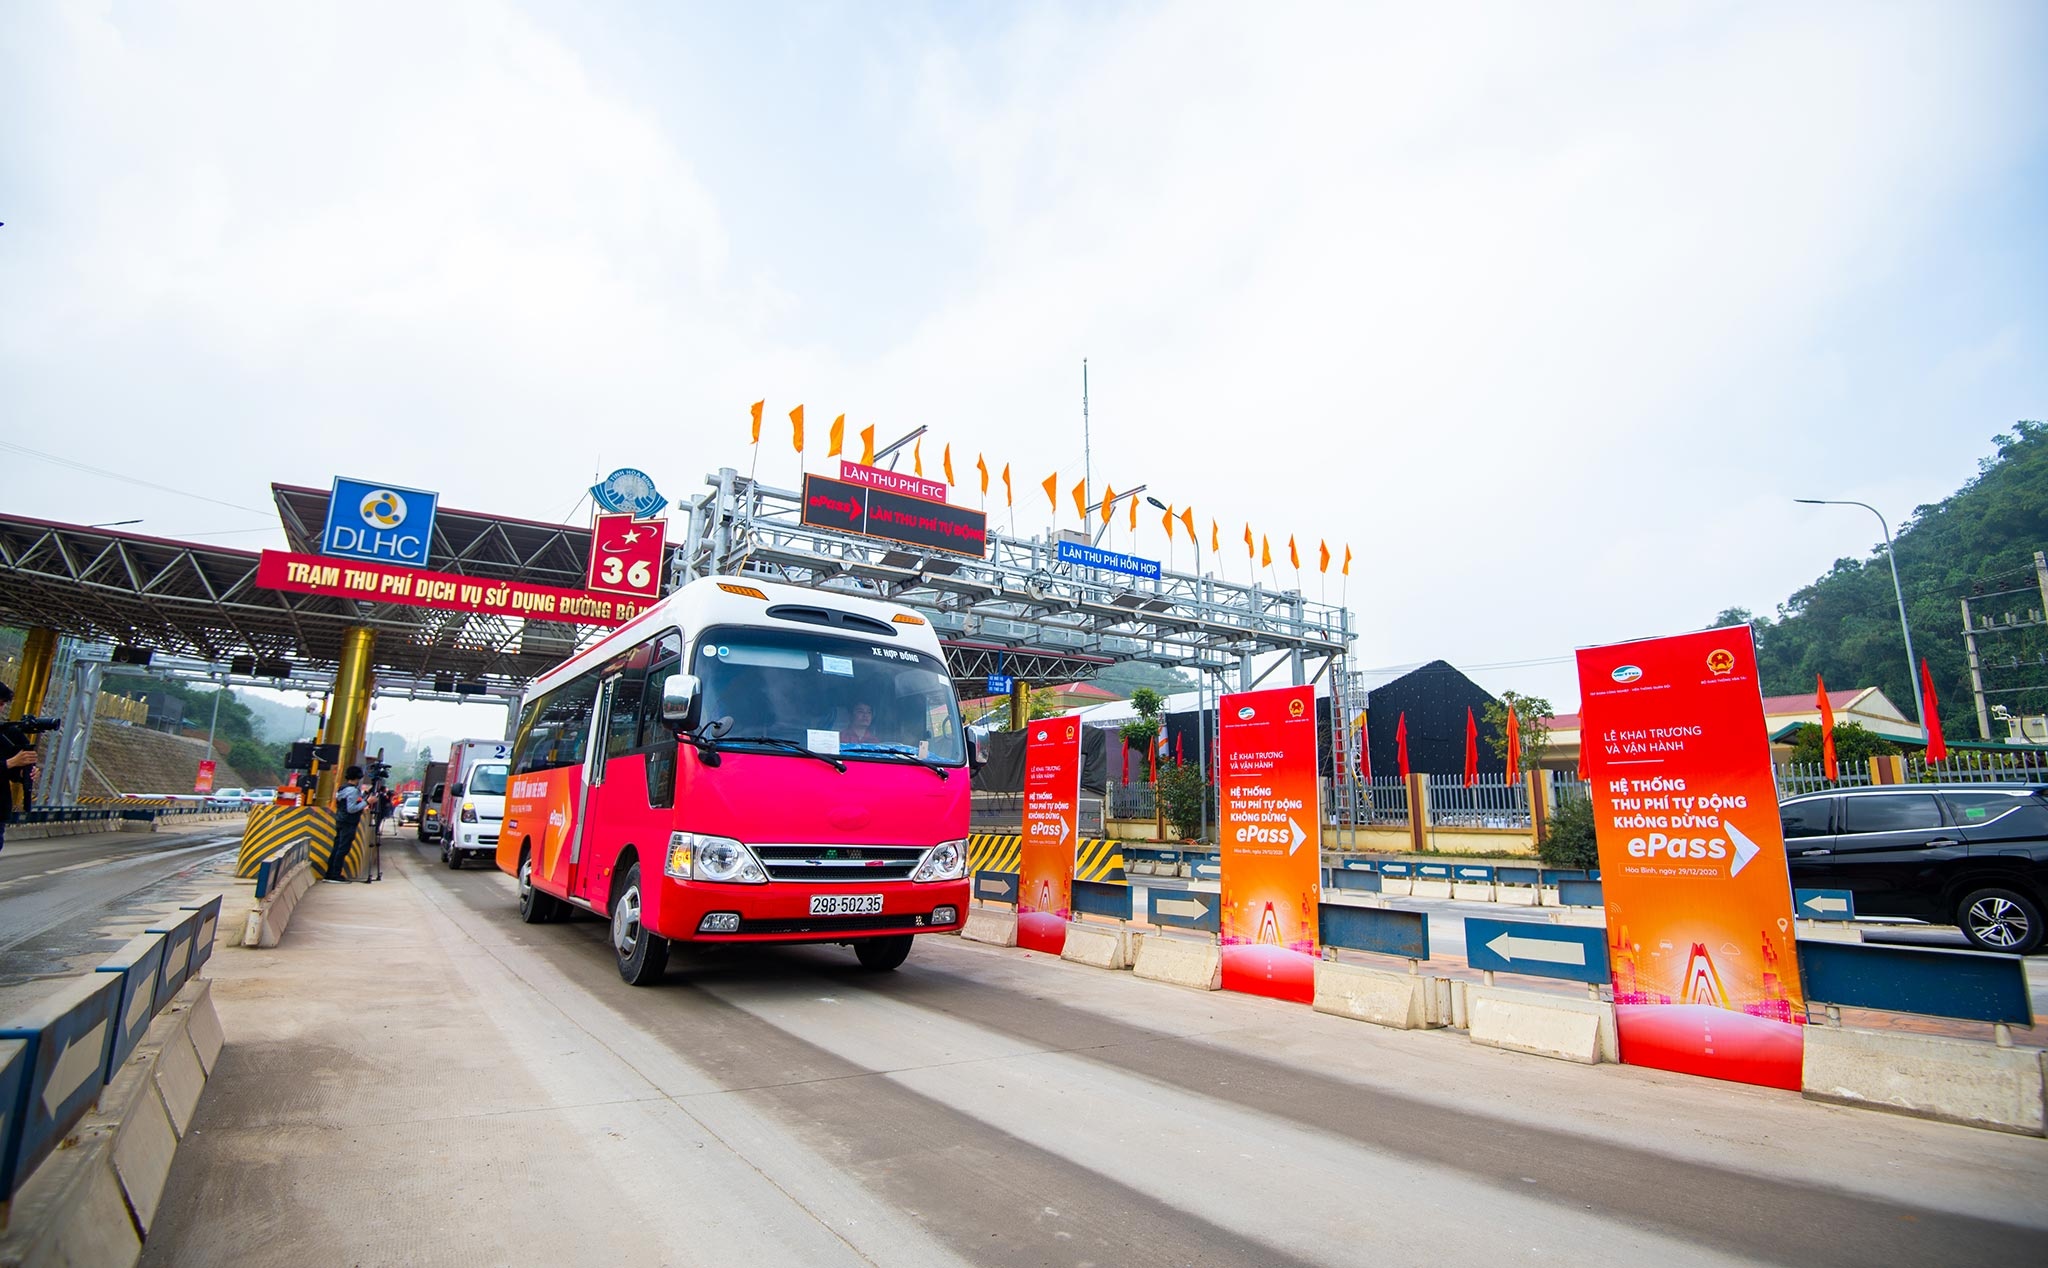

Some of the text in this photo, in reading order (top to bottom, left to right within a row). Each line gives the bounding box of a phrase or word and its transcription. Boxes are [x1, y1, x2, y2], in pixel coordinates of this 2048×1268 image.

[843, 466, 943, 498] LÀN THU PHÍ ETC
[809, 496, 850, 513] ePass
[869, 505, 984, 541] LÀN THU PHÍ TỰ ĐỘNG
[332, 526, 420, 558] DLHC
[1063, 546, 1157, 575] LÀN THU PHÍ HỖN HỢP
[601, 557, 651, 588] 36
[287, 562, 340, 588] TRẠM
[344, 569, 379, 591] THU
[380, 574, 413, 596] PHÍ
[415, 579, 457, 602] DỊCH
[461, 585, 482, 608] VỤ
[485, 582, 510, 607] SỬ
[512, 591, 555, 613] DỤNG
[560, 594, 612, 619] ĐƯỜNG
[871, 647, 882, 656] XE
[883, 649, 898, 659] HỢP
[1603, 726, 1702, 741] LỄ KHAI TRƯƠNG
[1230, 752, 1237, 760] LỄ
[1256, 751, 1283, 760] TRƯƠNG
[1605, 740, 1684, 755] VÀ VẬN HÀNH
[1230, 761, 1273, 771] VÀ VẬN HÀNH
[1230, 785, 1271, 799] HỆ THỐNG
[1610, 776, 1686, 795] HỆ THỐNG
[1231, 798, 1302, 811] THU PHÍ TỰ ĐỘNG
[1611, 793, 1747, 813] THU PHÍ TỰ ĐỘNG
[1230, 811, 1287, 822] KHÔNG DỪNG
[1613, 813, 1719, 828] KHÔNG DỪNG
[1031, 822, 1060, 836] ePass
[1236, 825, 1289, 843] ePass
[1627, 833, 1726, 859] ePass
[1625, 866, 1639, 874] Hòa
[1659, 868, 1676, 876] ngày
[1678, 867, 1718, 876] 29/12/2020
[813, 897, 881, 913] 29B-502.35
